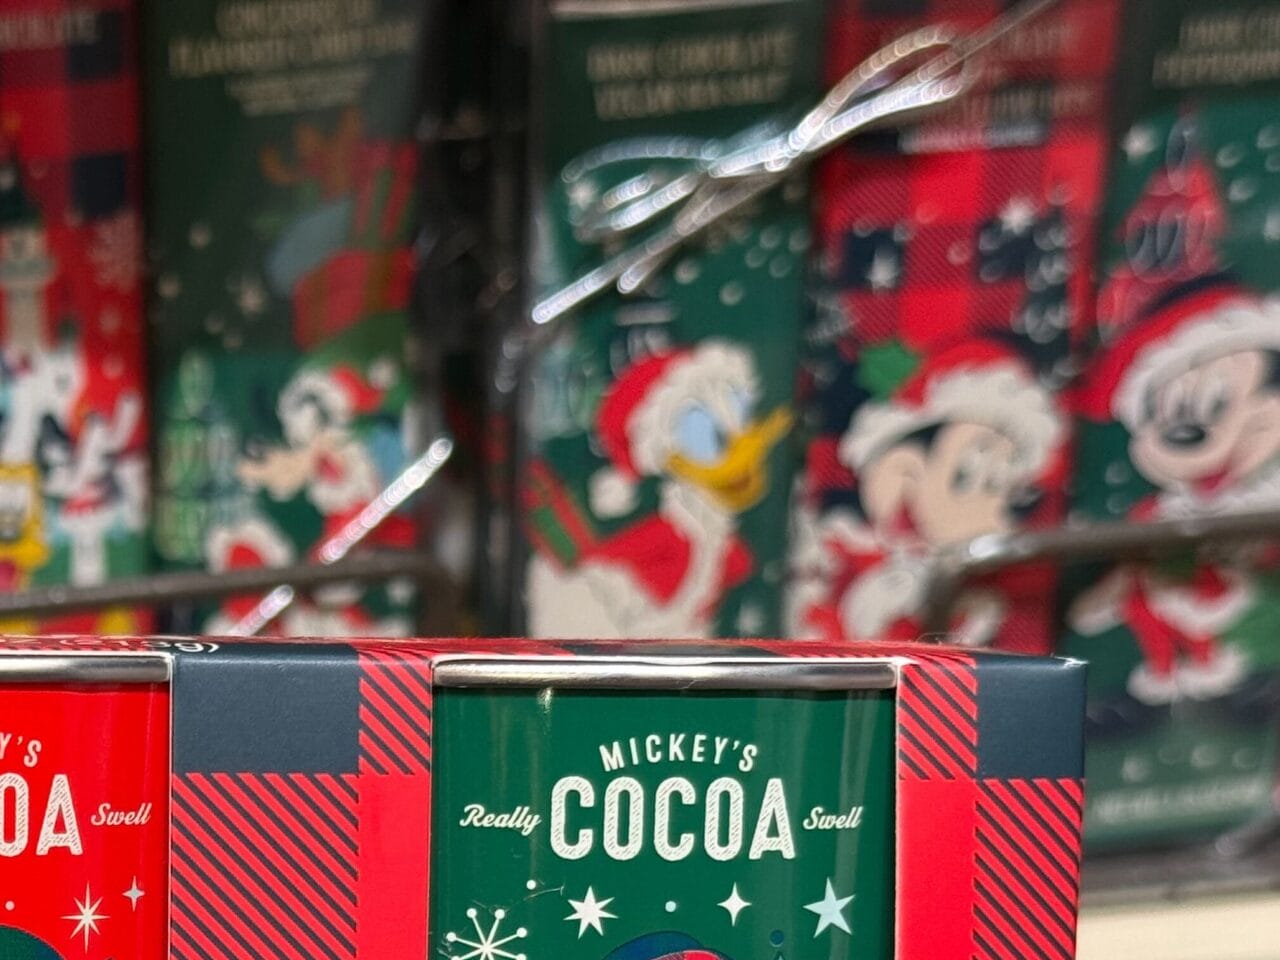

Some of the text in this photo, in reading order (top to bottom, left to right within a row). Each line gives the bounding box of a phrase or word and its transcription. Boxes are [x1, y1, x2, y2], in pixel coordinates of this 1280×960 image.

[599, 734, 758, 772] MICKEY'S
[91, 803, 151, 826] Swell
[460, 776, 863, 861] Really COCOA Swell
